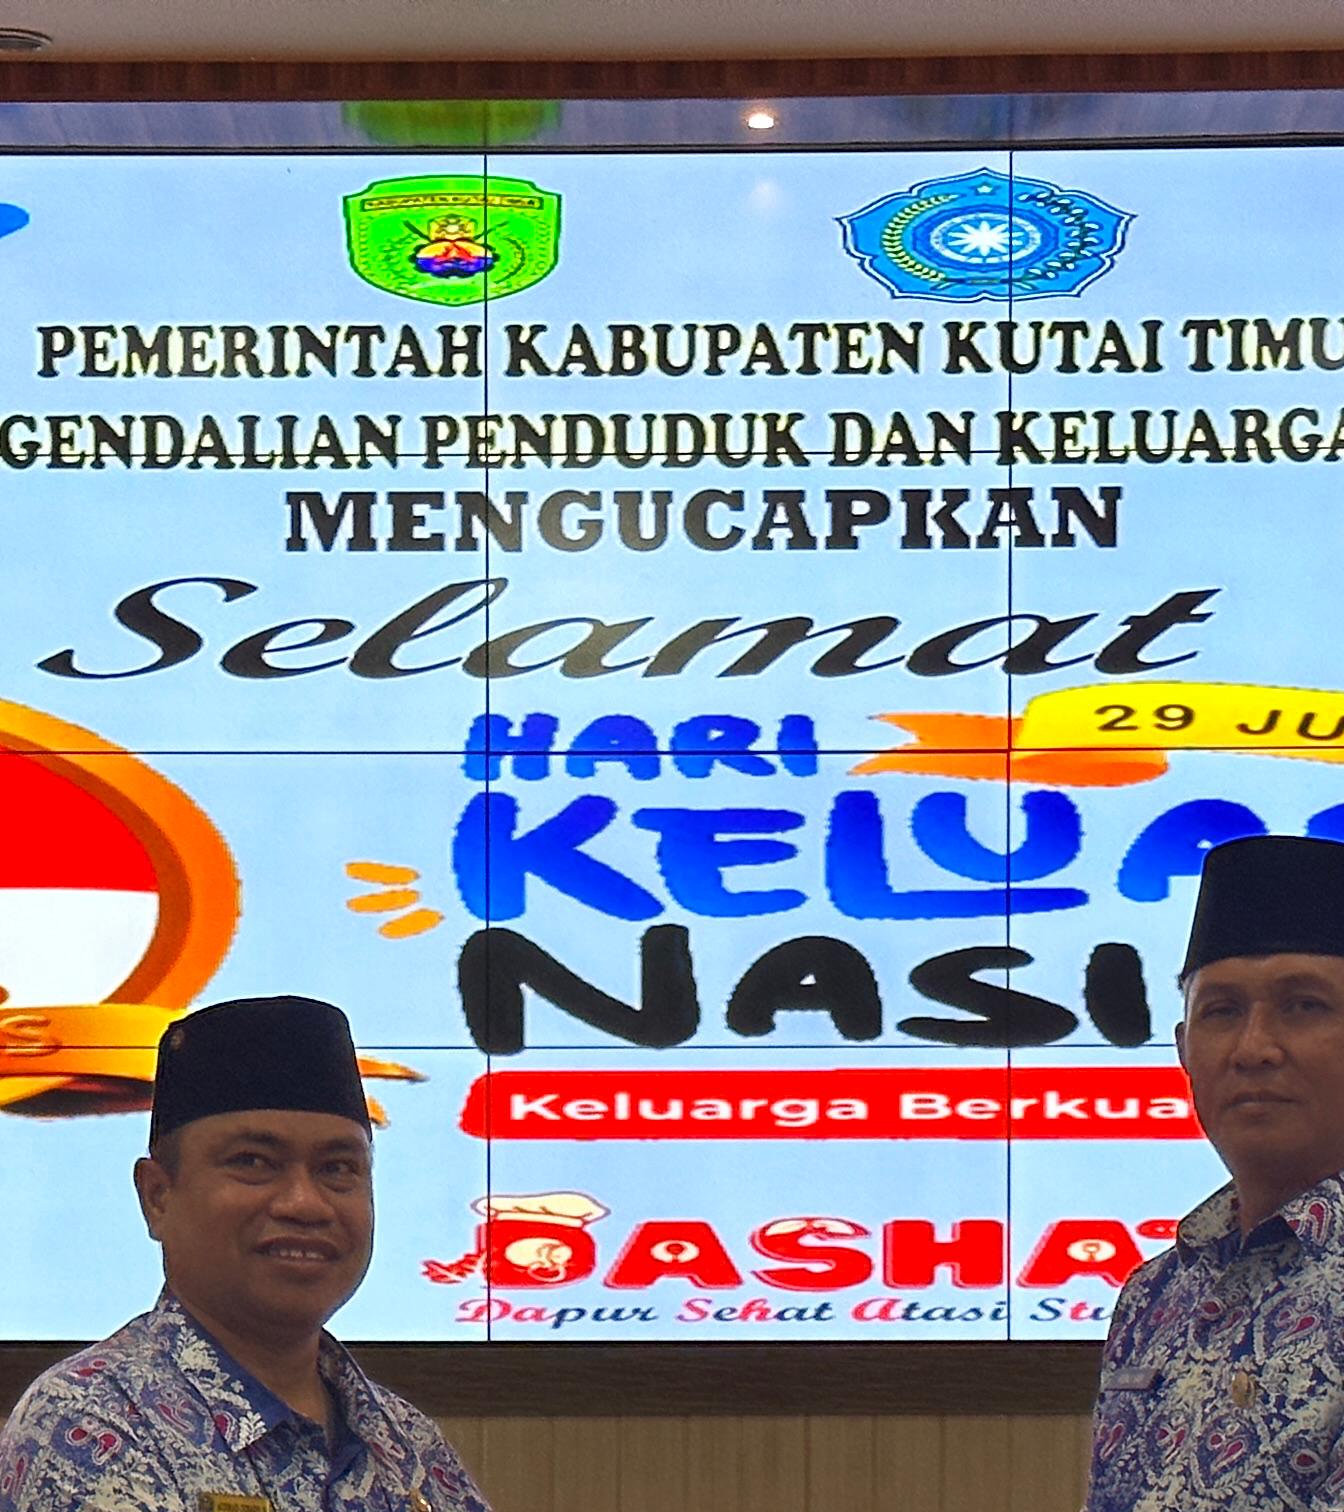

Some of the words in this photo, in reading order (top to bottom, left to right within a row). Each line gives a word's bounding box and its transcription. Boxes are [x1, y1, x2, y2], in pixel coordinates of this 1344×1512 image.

[37, 323, 483, 378] PEMERINTAH
[505, 320, 924, 376] KABUPATEN
[943, 319, 1164, 375] KUTAI
[422, 411, 809, 470] PENDUDUK
[826, 411, 978, 468] DAN
[285, 485, 1123, 553] MENGUCAPKAN
[36, 576, 1222, 681] Selamat
[463, 711, 820, 781] HARI
[1094, 703, 1196, 732] 29
[509, 1090, 870, 1127] Keluarga
[900, 1091, 1192, 1121] Berkua
[456, 1298, 658, 1330] Dapur
[676, 1298, 835, 1322] Sehat
